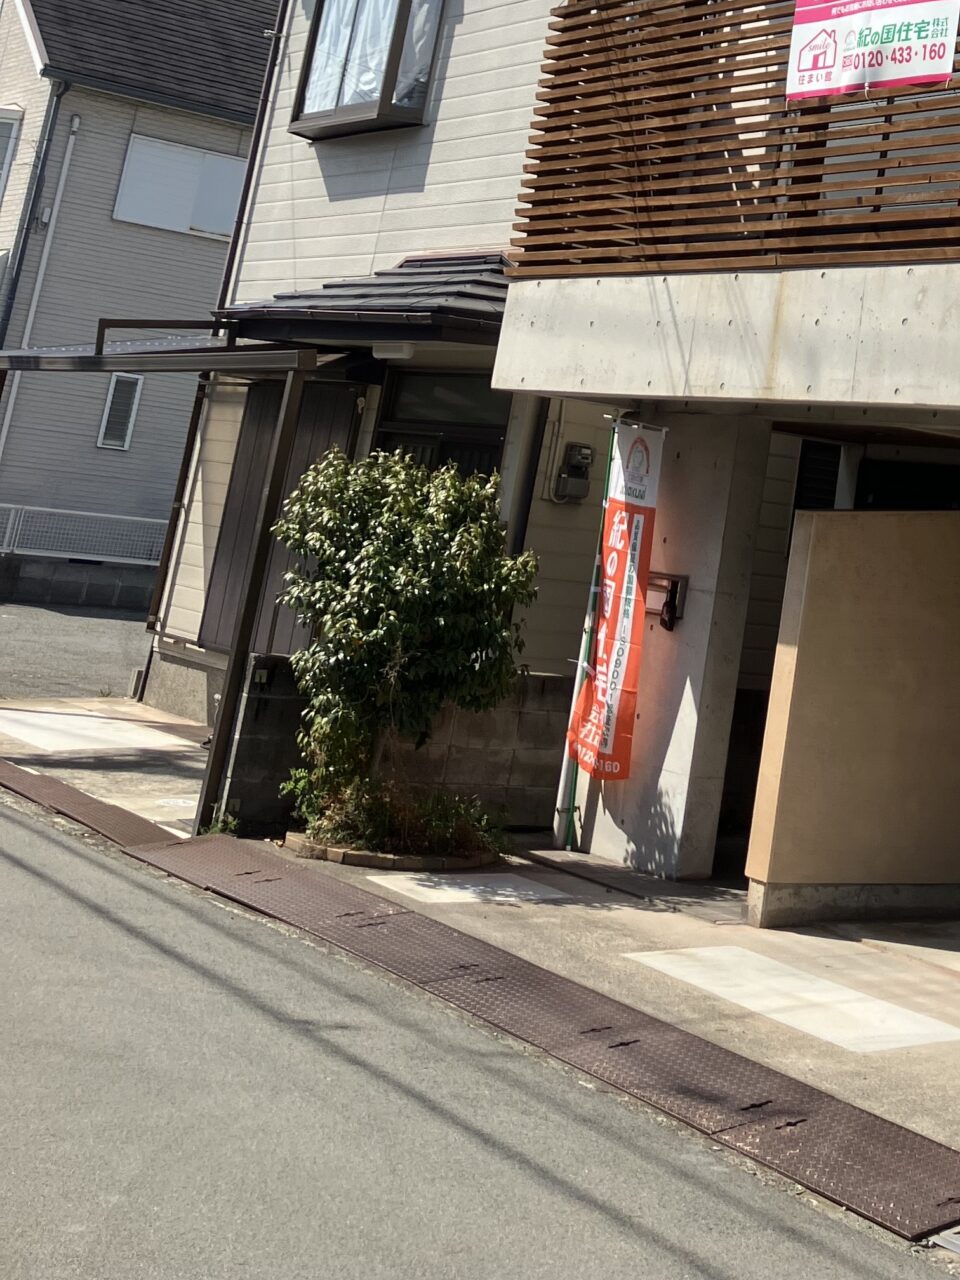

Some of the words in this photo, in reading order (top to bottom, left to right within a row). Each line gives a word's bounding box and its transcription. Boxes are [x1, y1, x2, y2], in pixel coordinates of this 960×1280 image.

[856, 20, 931, 49] 紀の国住宅
